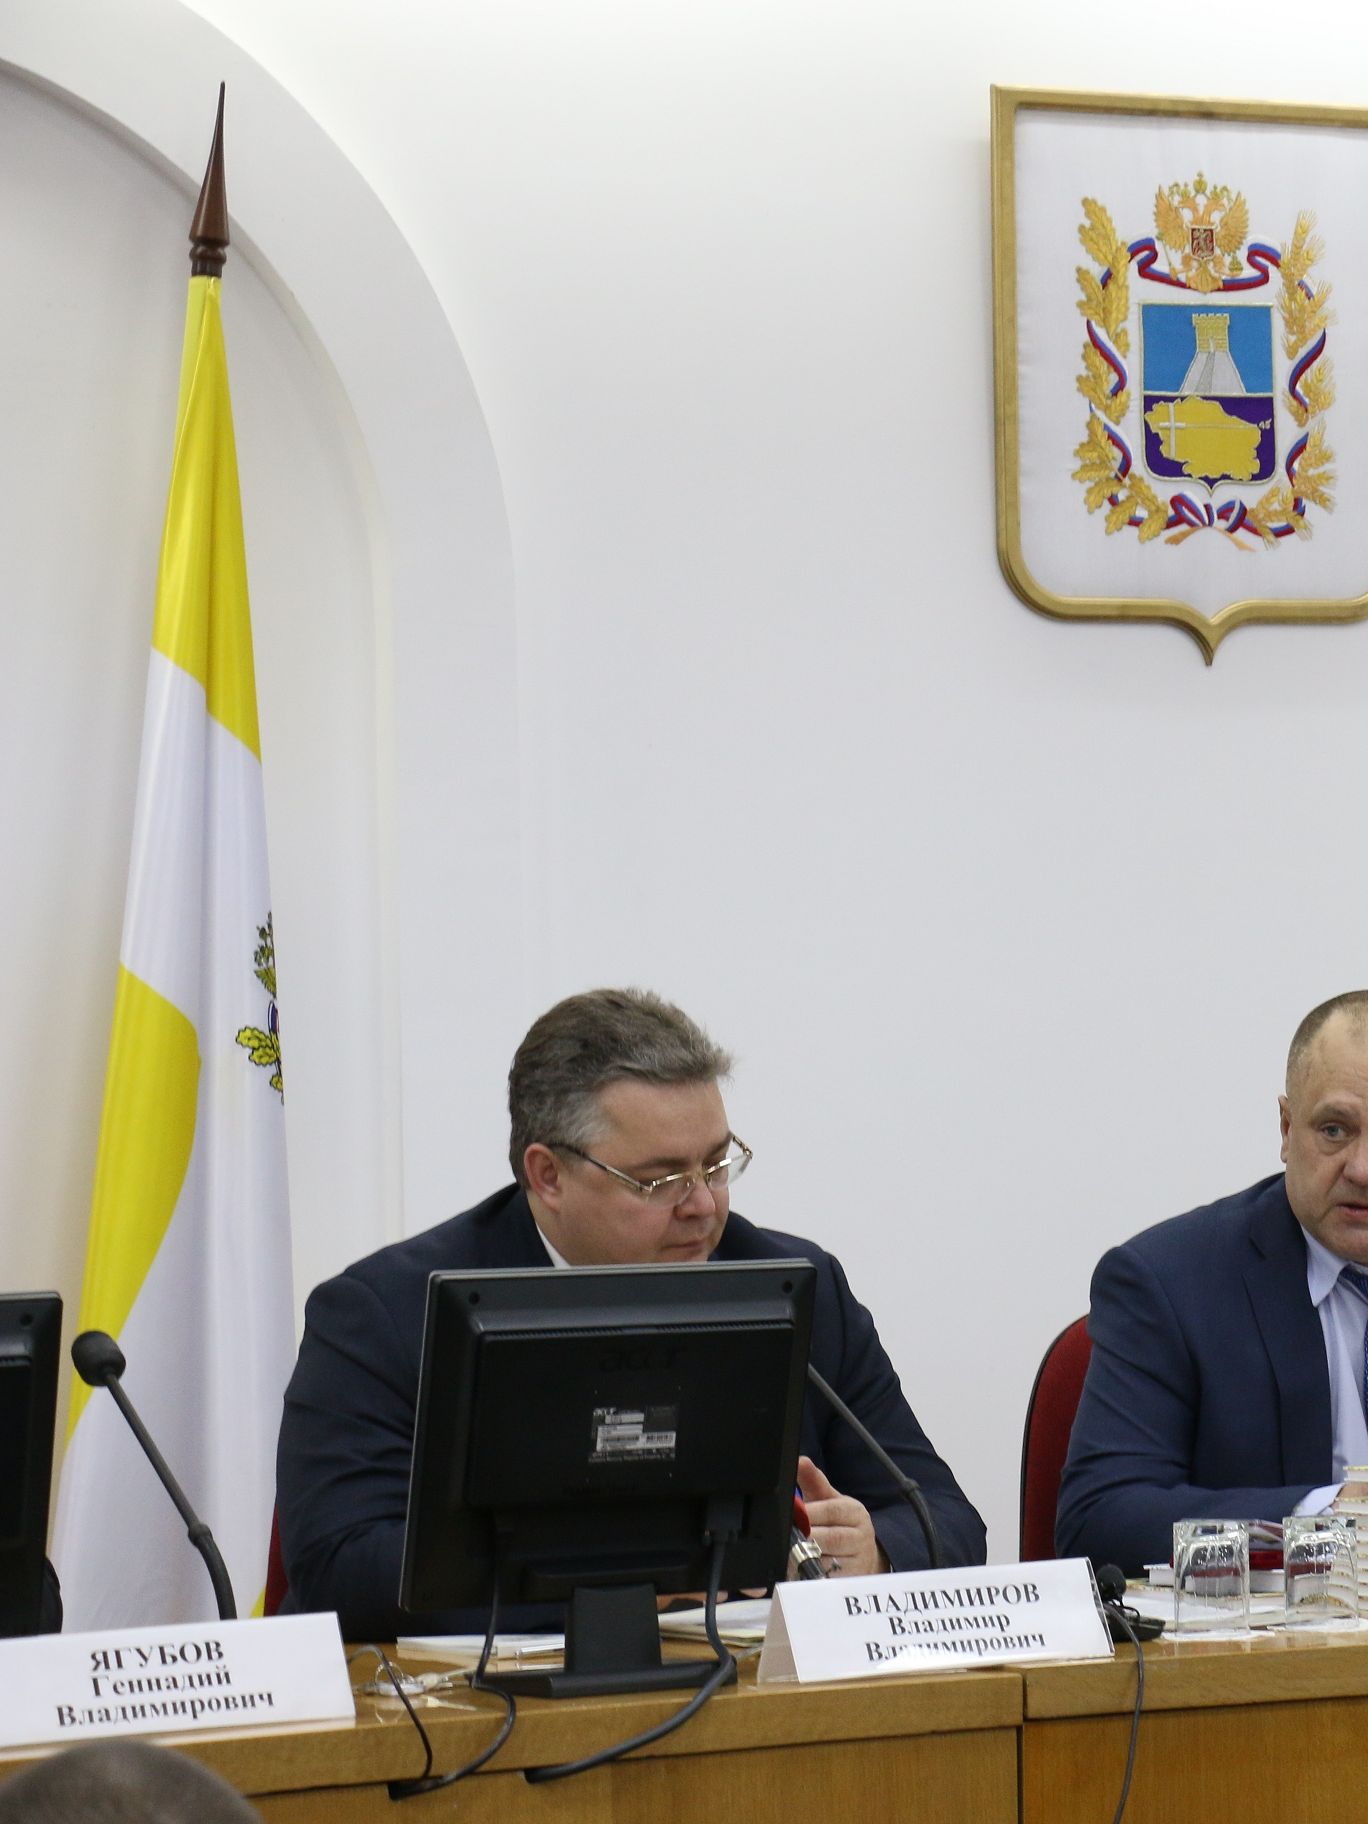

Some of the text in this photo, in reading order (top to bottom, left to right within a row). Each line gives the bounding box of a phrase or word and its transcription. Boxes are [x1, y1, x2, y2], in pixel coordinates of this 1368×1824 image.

[844, 1583, 1040, 1616] ВЛАДИМИРОВ
[889, 1612, 1010, 1636] Владимир
[90, 1640, 224, 1672] ЯГУБОВ
[865, 1633, 1046, 1661] Влимирович
[92, 1665, 231, 1697] Геннадий
[57, 1690, 274, 1727] Владимирович
